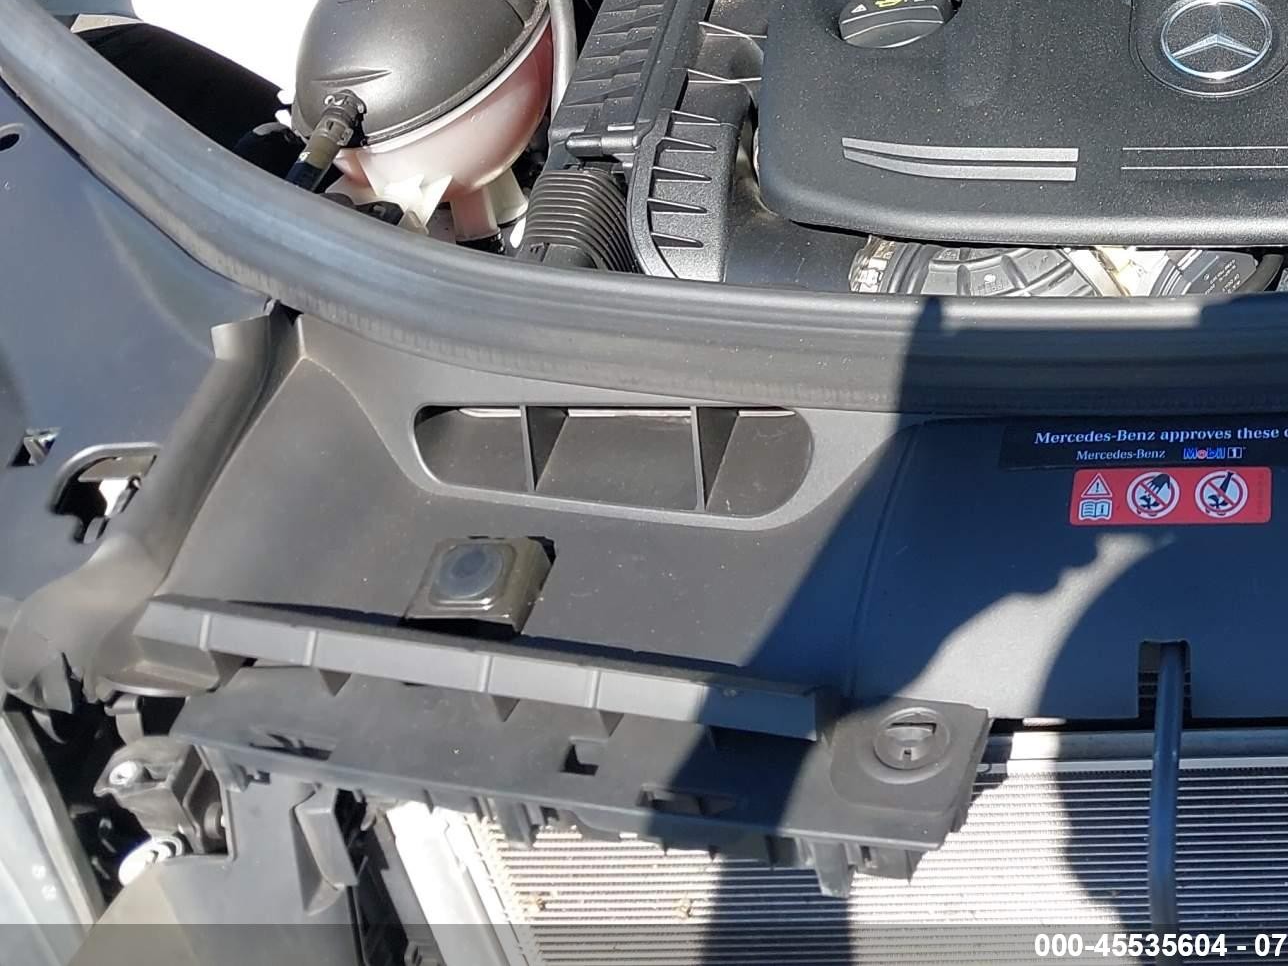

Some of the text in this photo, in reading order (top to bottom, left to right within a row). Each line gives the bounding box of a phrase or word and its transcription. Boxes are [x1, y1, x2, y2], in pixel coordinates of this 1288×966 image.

[1034, 429, 1157, 445] Mercedes-Benz
[1160, 430, 1232, 443] approves
[1237, 426, 1280, 440] these
[1076, 448, 1167, 461] Mercedes-Benz
[1183, 447, 1226, 460] Mobil
